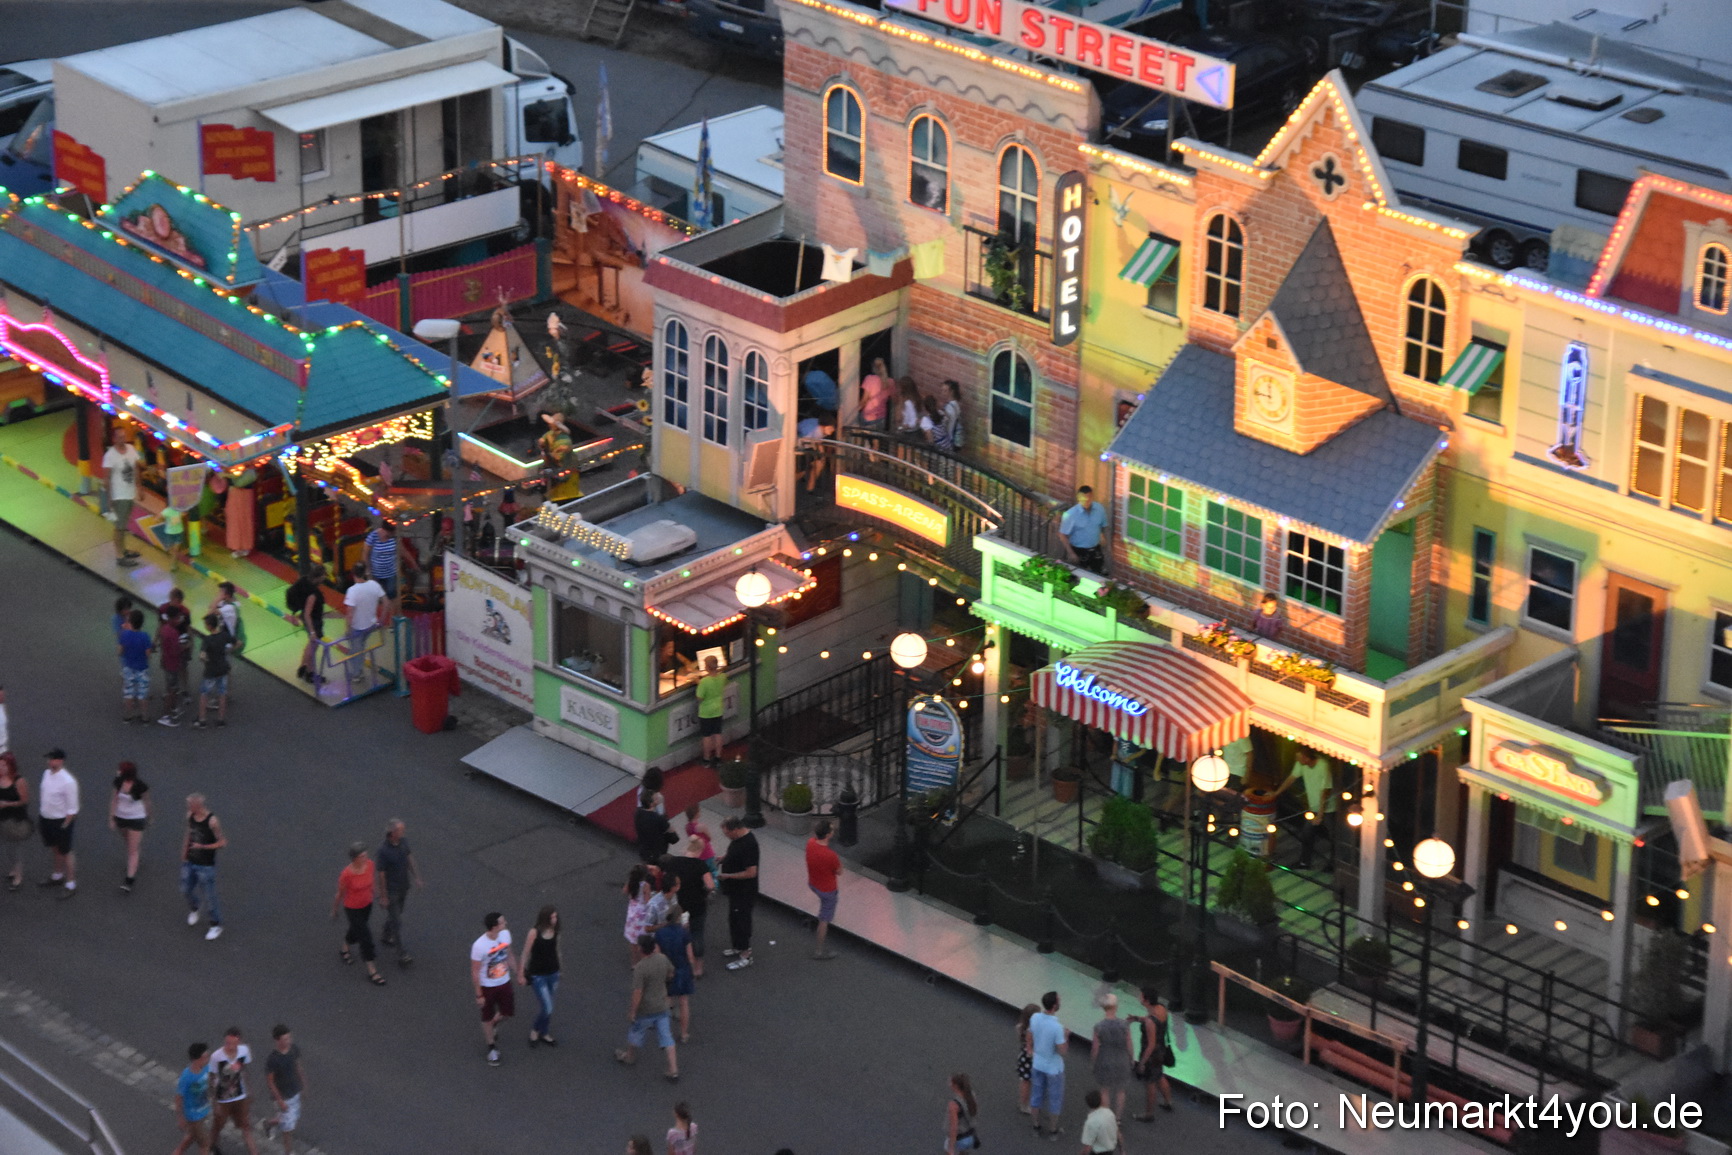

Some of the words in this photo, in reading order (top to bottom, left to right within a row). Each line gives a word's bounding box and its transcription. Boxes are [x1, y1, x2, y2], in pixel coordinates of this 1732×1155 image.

[1020, 8, 1196, 92] STREET
[1060, 182, 1083, 336] HOTEL
[566, 698, 614, 730] KASSE
[1055, 660, 1149, 716] Welcome
[1502, 751, 1594, 796] CASINO
